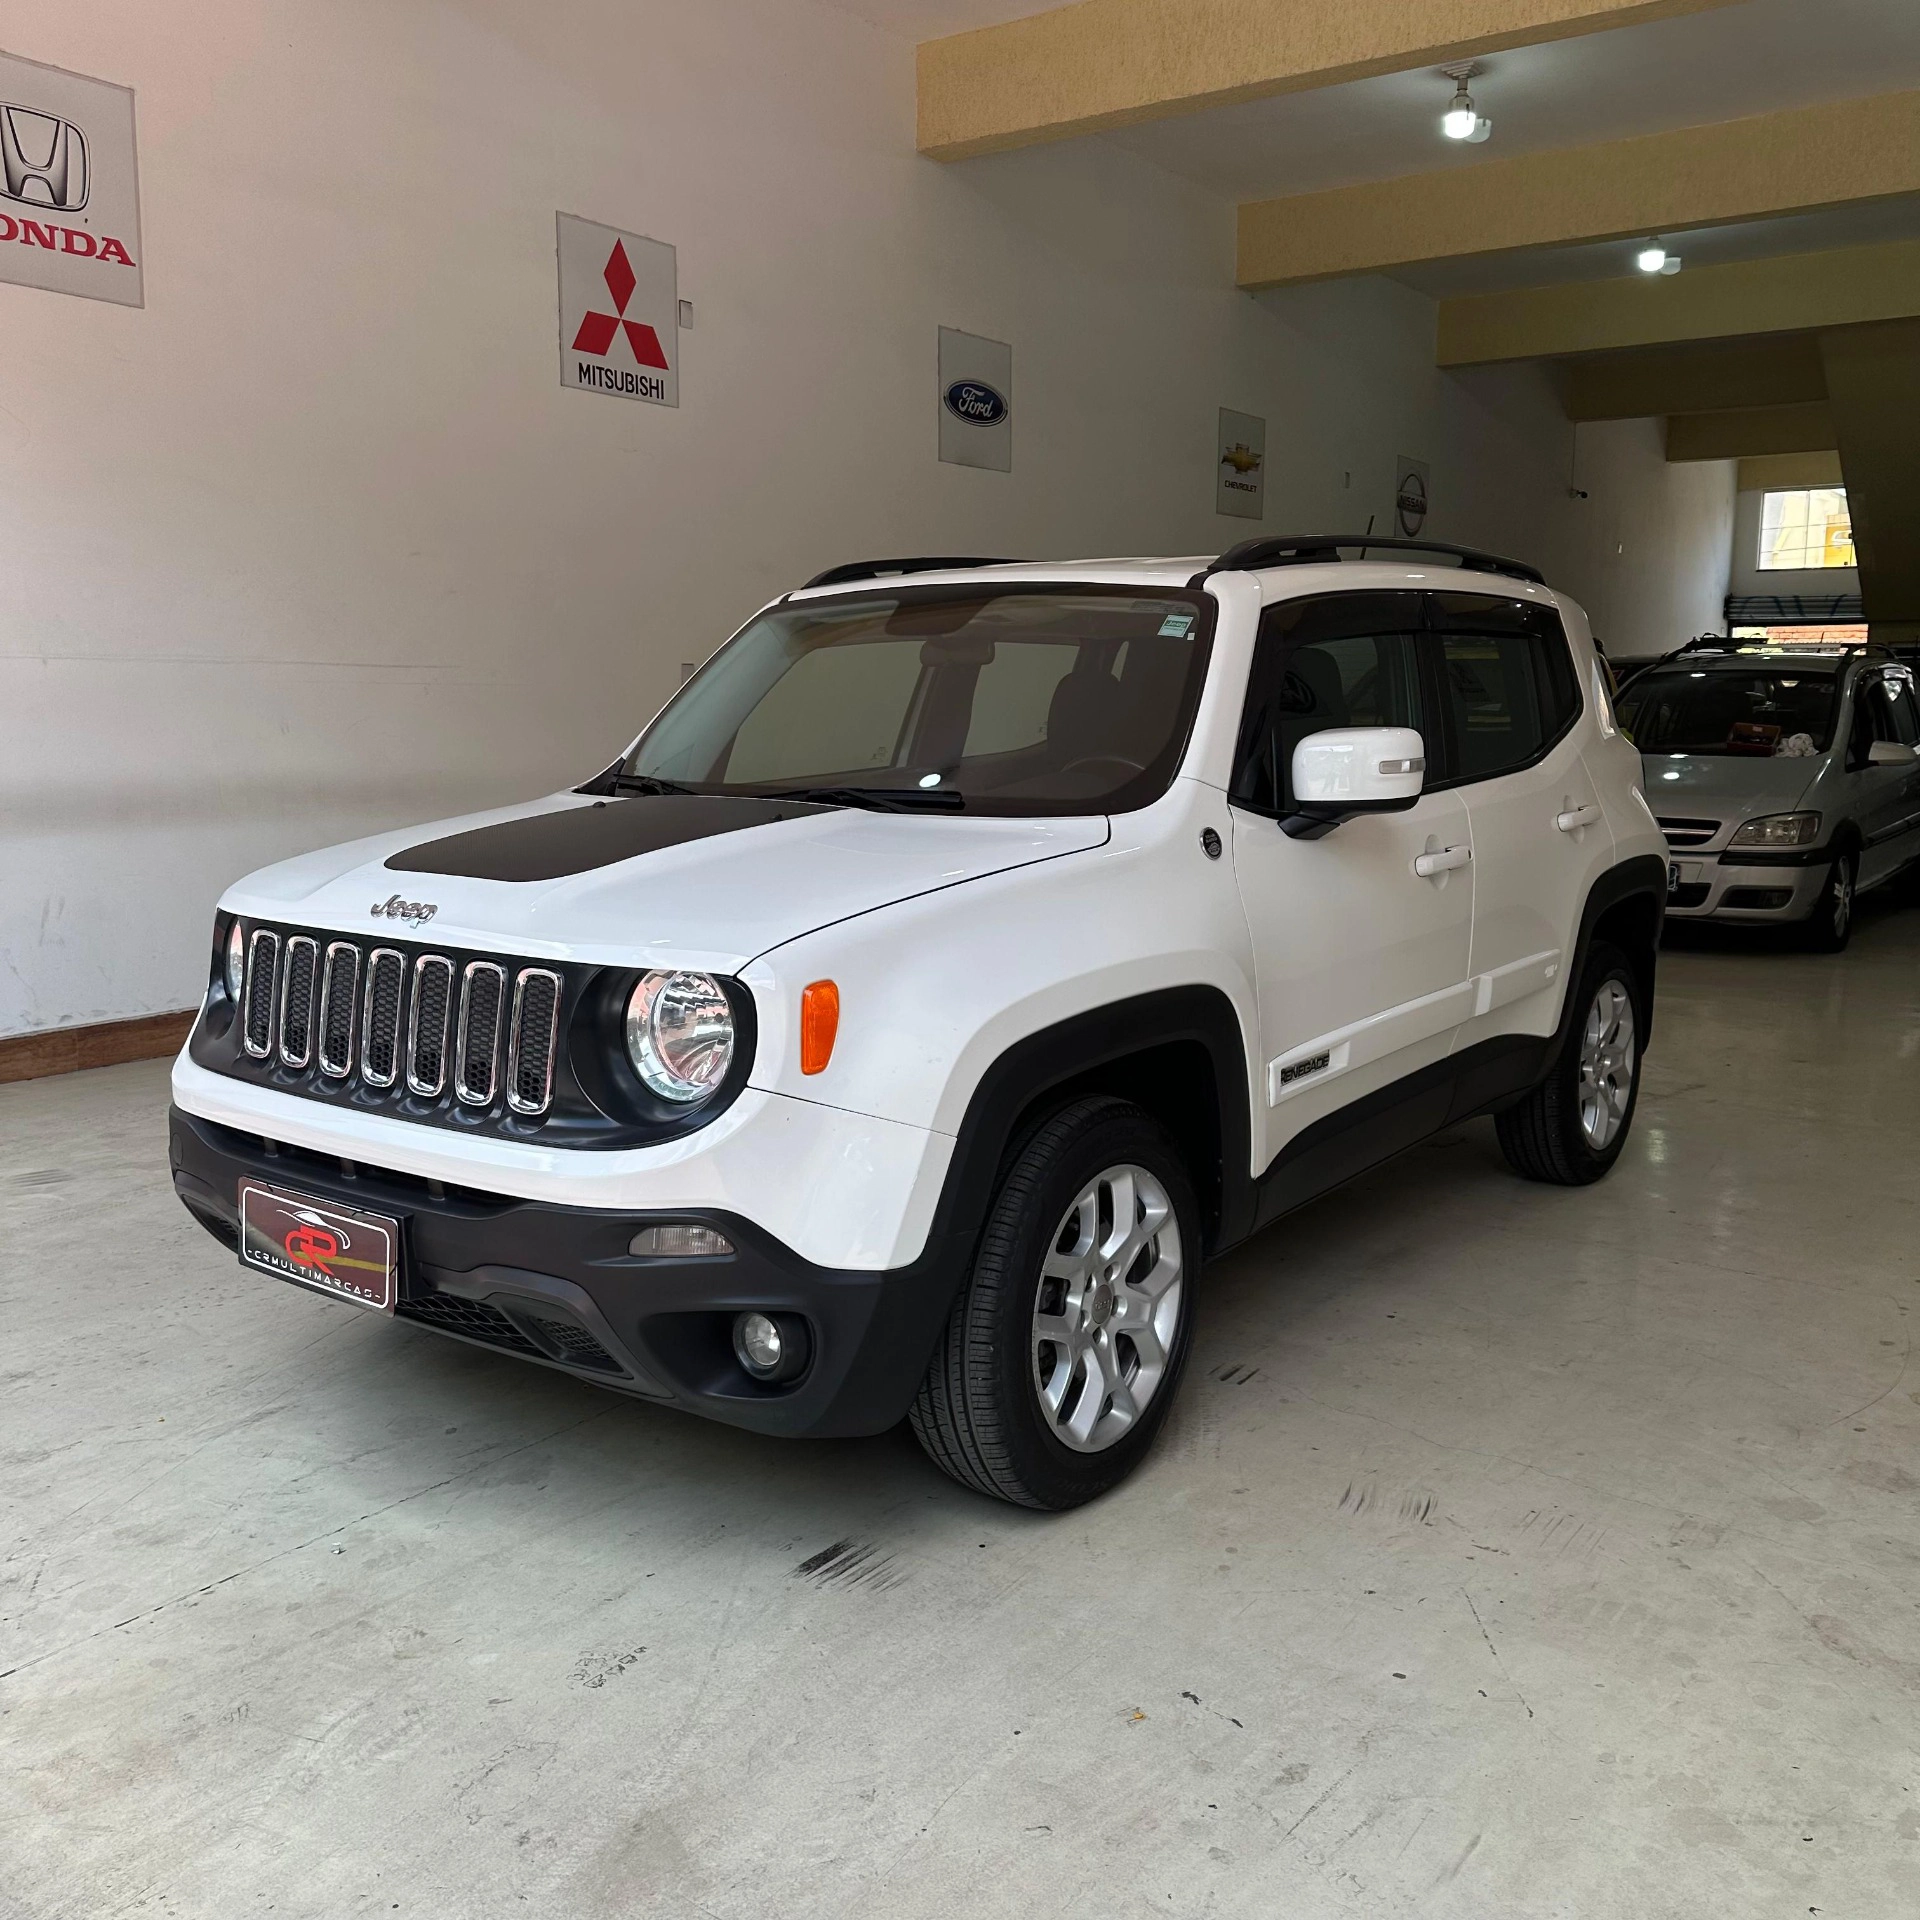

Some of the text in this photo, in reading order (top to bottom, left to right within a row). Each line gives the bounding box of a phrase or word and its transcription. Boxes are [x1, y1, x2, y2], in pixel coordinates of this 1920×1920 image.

[578, 362, 665, 400] MITSUBISHI
[958, 386, 994, 417] Ford
[370, 894, 438, 928] Jeep
